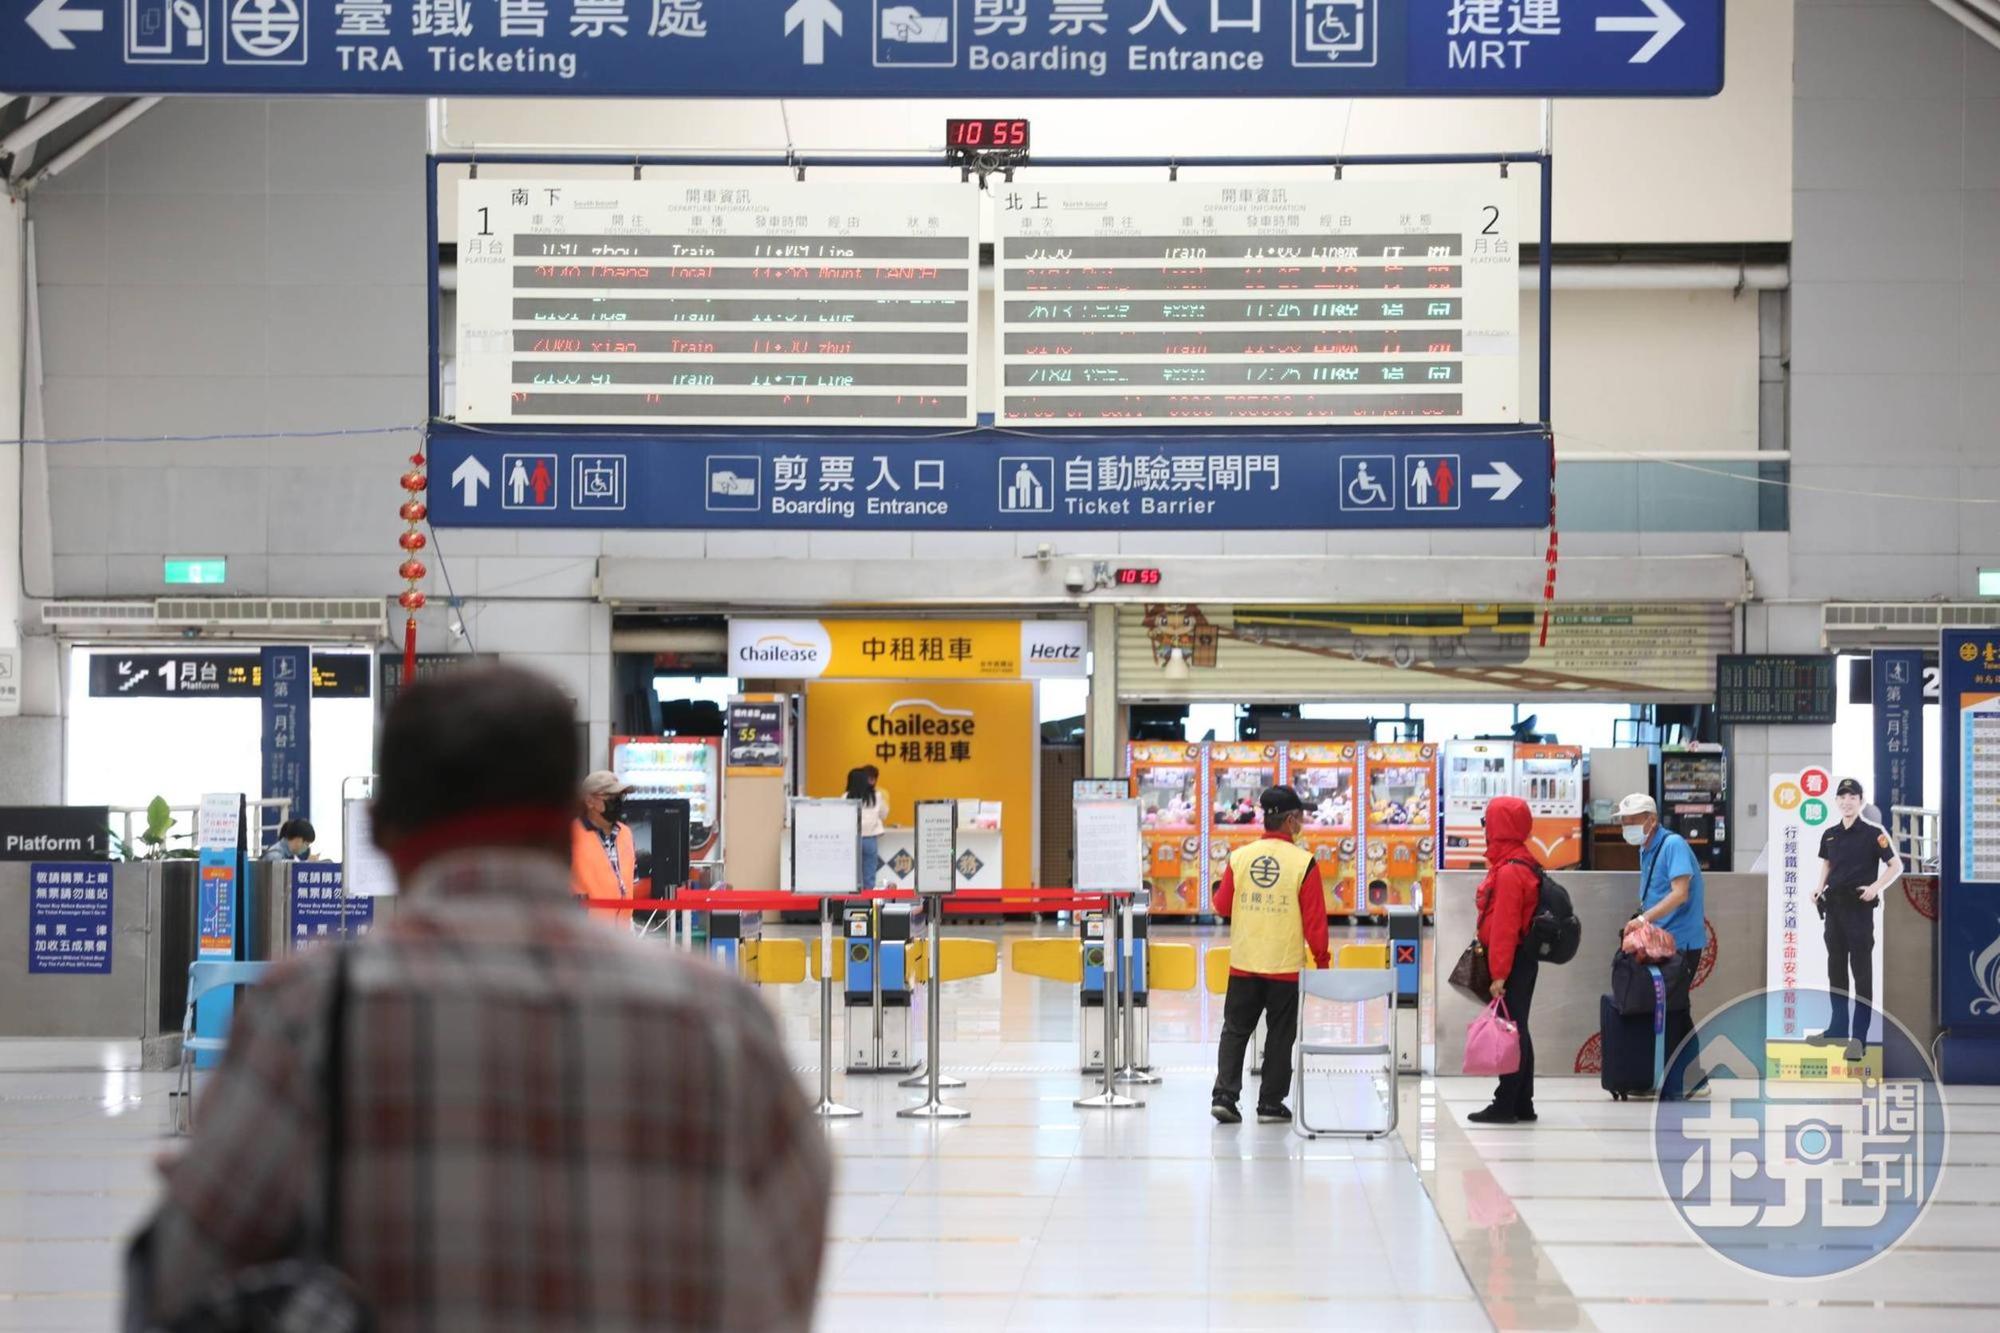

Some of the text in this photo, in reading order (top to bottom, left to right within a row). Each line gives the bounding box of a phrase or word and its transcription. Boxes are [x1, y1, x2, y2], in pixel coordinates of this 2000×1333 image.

[336, 46, 578, 78] TRA Ticketing
[969, 46, 1264, 76] Boarding Entrance
[1448, 40, 1531, 69] MRT
[511, 188, 562, 207] 南下
[686, 188, 752, 205] 開車資訊
[1005, 191, 1049, 210] 北上
[1222, 188, 1288, 204] 開車資訊
[1250, 205, 1306, 213] INFORMATION
[477, 206, 494, 236] 1
[532, 214, 566, 227] 車次
[612, 214, 645, 227] 開往
[1102, 216, 1134, 228] 開往
[1320, 215, 1351, 227] 經由
[1481, 205, 1500, 235] 2
[468, 238, 504, 255] 月台
[1473, 238, 1509, 254] 月台
[773, 456, 946, 491] 剪票入口
[1064, 455, 1280, 491] 自動驗票閘門
[772, 497, 948, 518] Boarding Entrance
[1065, 497, 1216, 515] Ticket Barrier
[740, 645, 817, 662] Chailease
[862, 637, 973, 662] 中租租車
[1030, 643, 1081, 659] Hertz
[158, 660, 177, 691] 1
[180, 661, 218, 682] 月台
[180, 681, 220, 691] Platform
[1923, 667, 1940, 697] 2
[273, 682, 289, 748] 第一月台
[1886, 686, 1902, 753] 第二月台
[739, 728, 757, 742] 55
[867, 714, 975, 737] Chailease
[875, 741, 972, 764] 中租租車
[1806, 774, 1823, 792] 看
[6, 835, 96, 852] Platform 1
